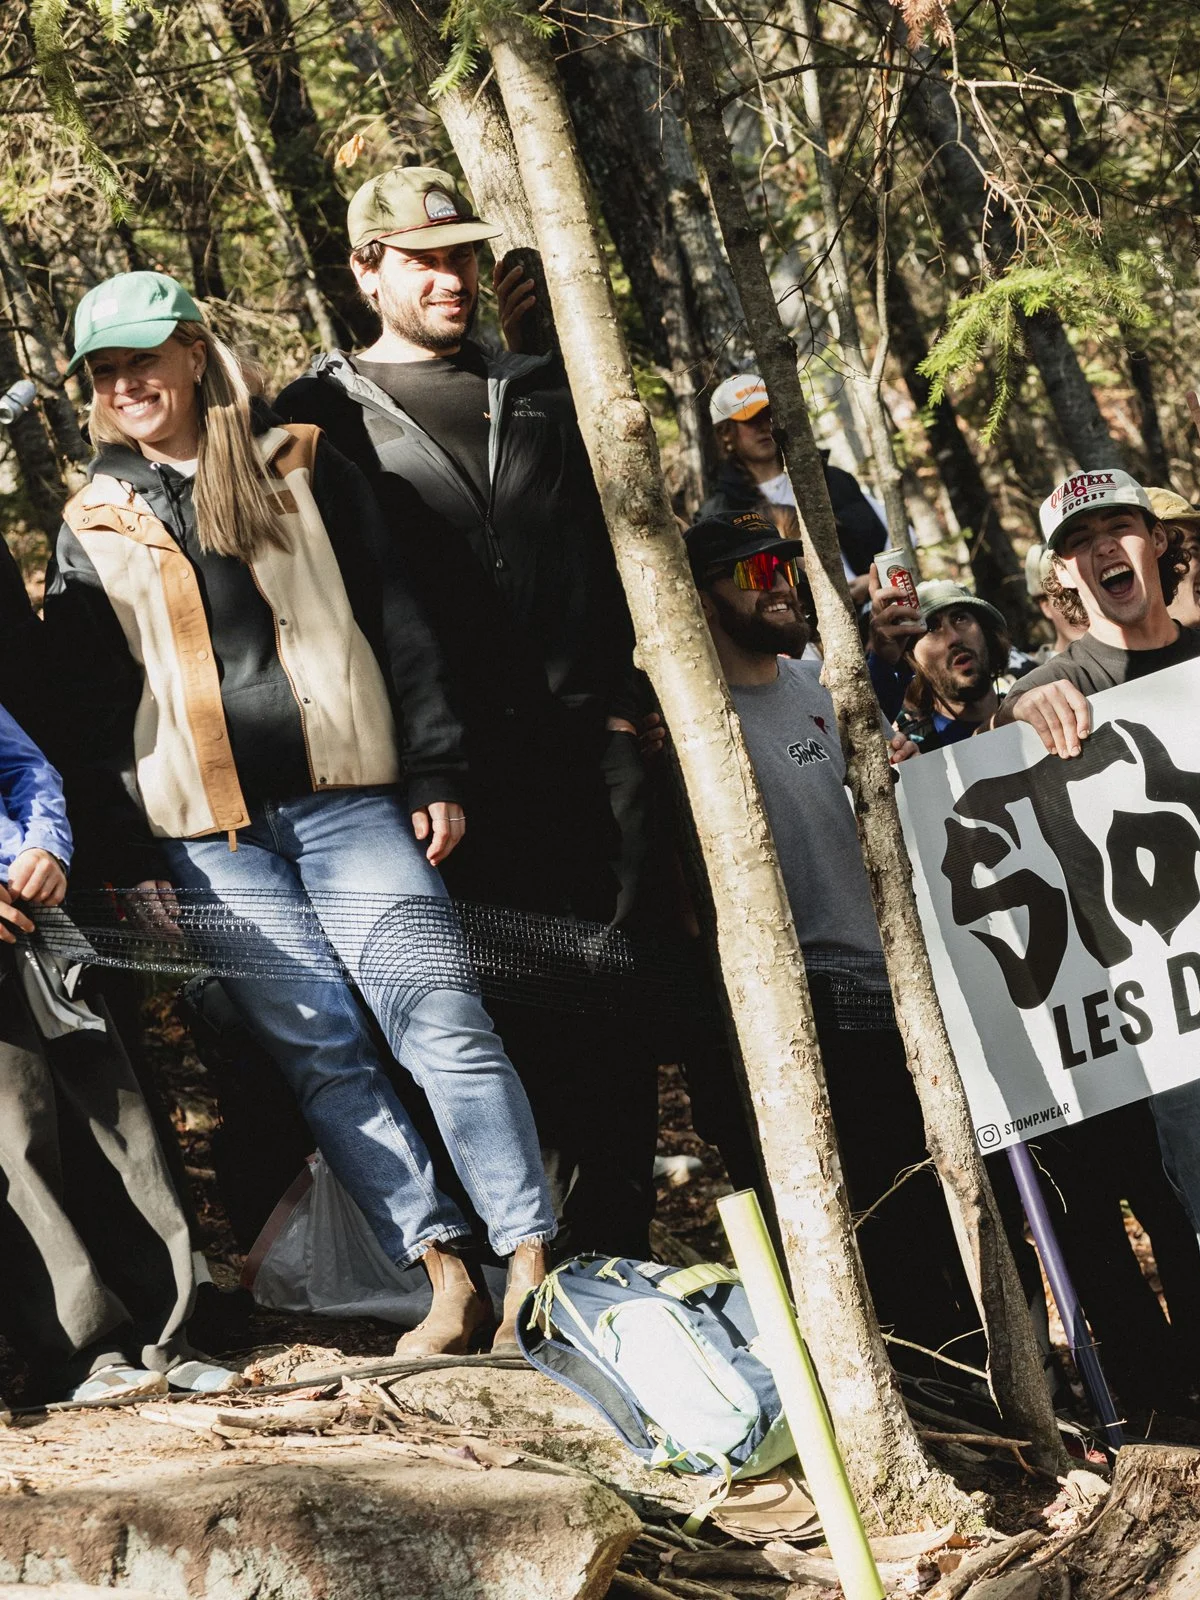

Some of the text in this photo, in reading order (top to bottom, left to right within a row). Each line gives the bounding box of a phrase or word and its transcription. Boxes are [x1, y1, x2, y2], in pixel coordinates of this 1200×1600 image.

[1050, 473, 1116, 509] QUARTEXX
[1061, 492, 1106, 516] HOCKEY
[1052, 979, 1154, 1070] LES
[1004, 1102, 1071, 1135] STOMP.WEAR
